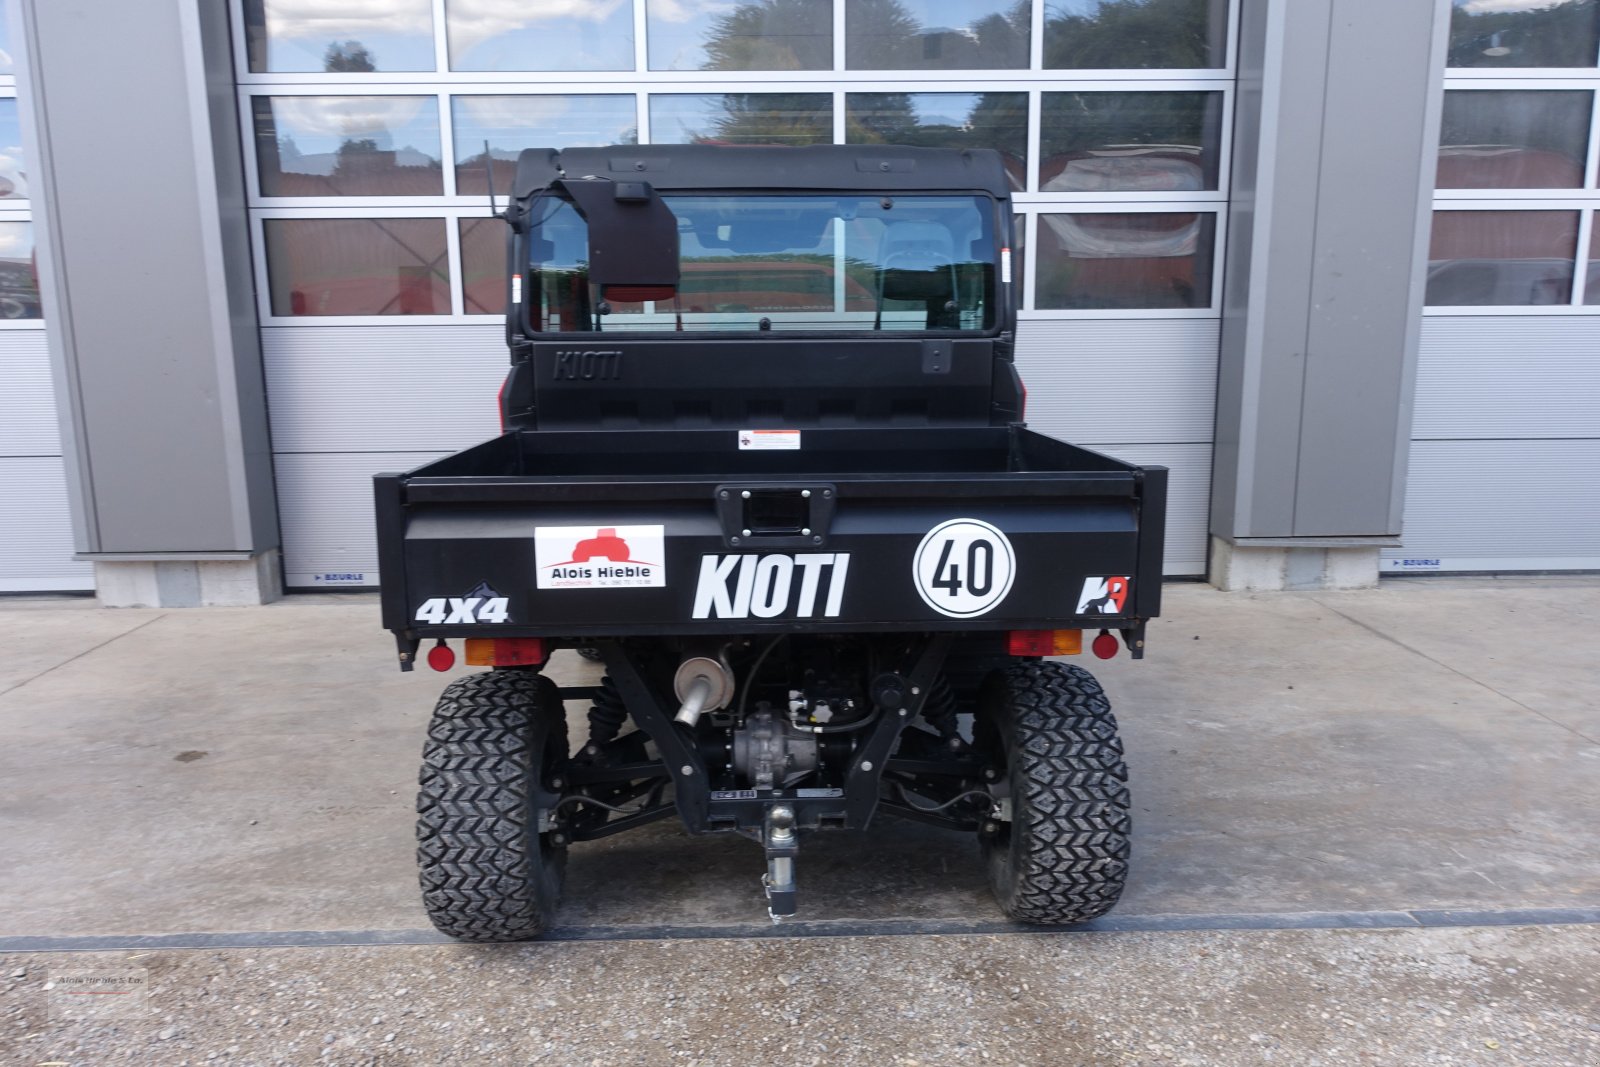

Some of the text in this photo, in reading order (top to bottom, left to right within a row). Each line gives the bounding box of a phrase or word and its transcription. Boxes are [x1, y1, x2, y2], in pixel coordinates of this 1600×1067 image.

[553, 351, 622, 379] KIOTI
[552, 566, 651, 579] Alois Hieble
[932, 539, 993, 597] 40
[692, 553, 850, 619] KIOTI
[1075, 576, 1131, 614] K9
[415, 597, 509, 624] 4X4
